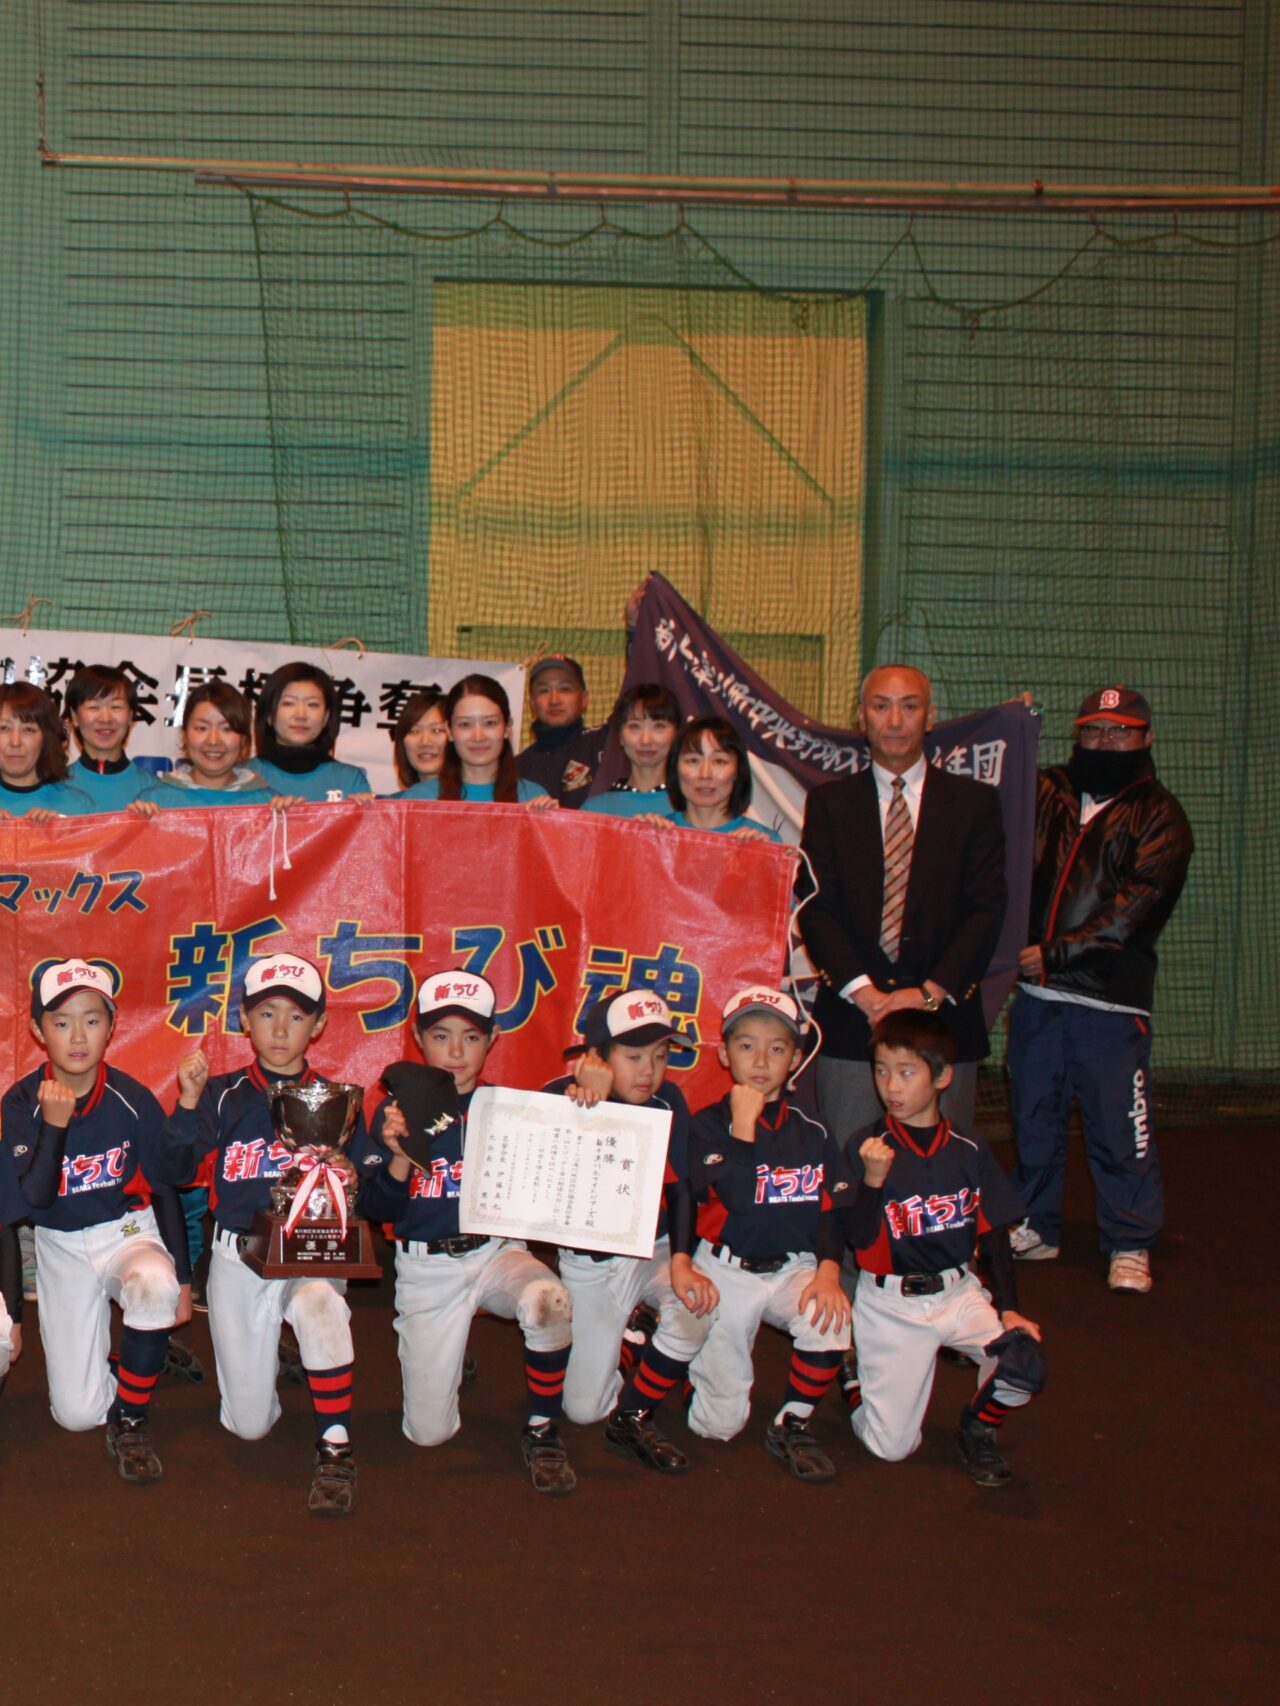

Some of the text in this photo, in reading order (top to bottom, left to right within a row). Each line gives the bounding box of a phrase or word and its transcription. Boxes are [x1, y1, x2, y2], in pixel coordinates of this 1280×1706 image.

[261, 964, 305, 983] 新ちび
[434, 983, 479, 1001] 新ちび
[1128, 1068, 1149, 1159] umbro
[223, 1138, 295, 1182] 新ち
[604, 1136, 617, 1164] 優勝
[616, 1158, 634, 1196] 賞状
